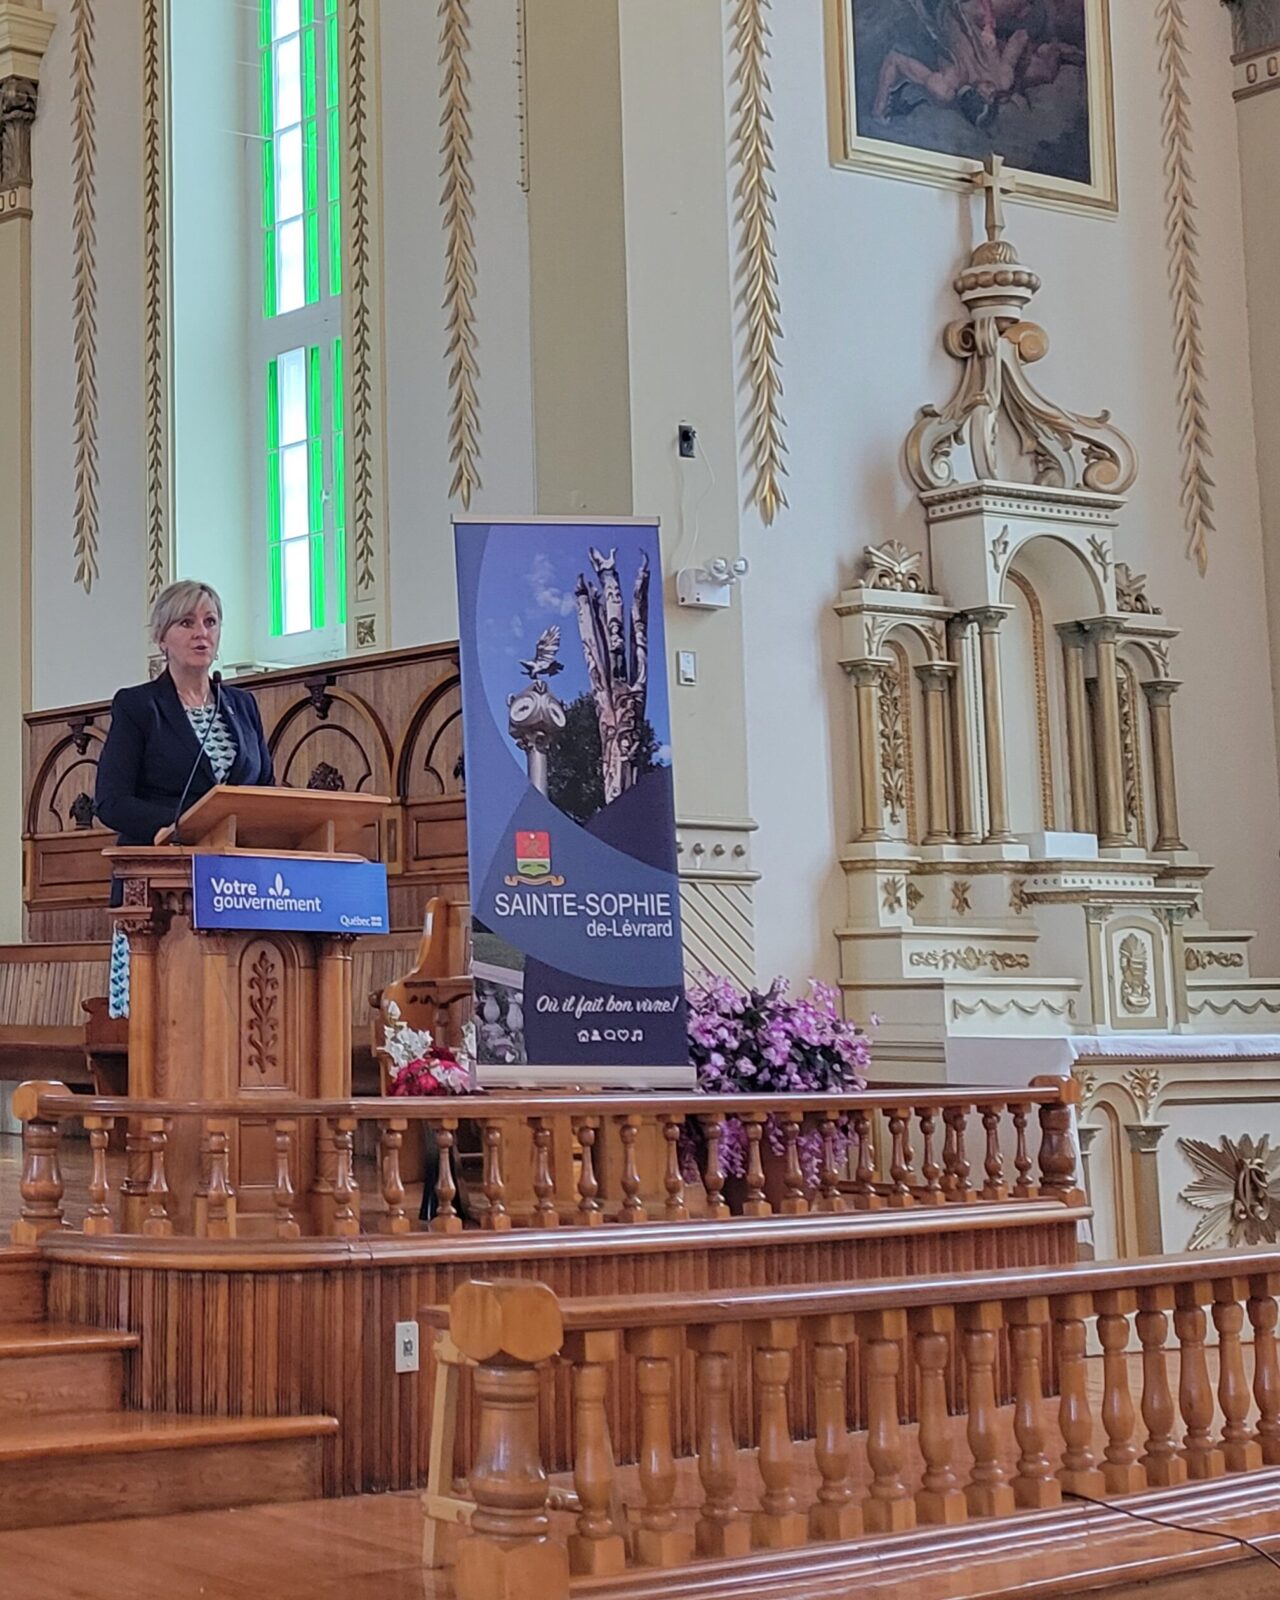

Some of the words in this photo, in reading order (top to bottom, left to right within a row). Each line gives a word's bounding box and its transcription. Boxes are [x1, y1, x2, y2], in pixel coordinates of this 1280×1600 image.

[210, 877, 257, 896] Votre
[213, 895, 322, 913] gouvernement
[494, 893, 672, 917] SAINTE-SOPHIE
[340, 915, 371, 928] Québec
[586, 919, 673, 937] de-Lévrard
[536, 995, 560, 1013] Où
[561, 995, 576, 1013] il
[575, 995, 606, 1019] fait
[605, 995, 634, 1013] bon
[636, 995, 680, 1013] vivre!
